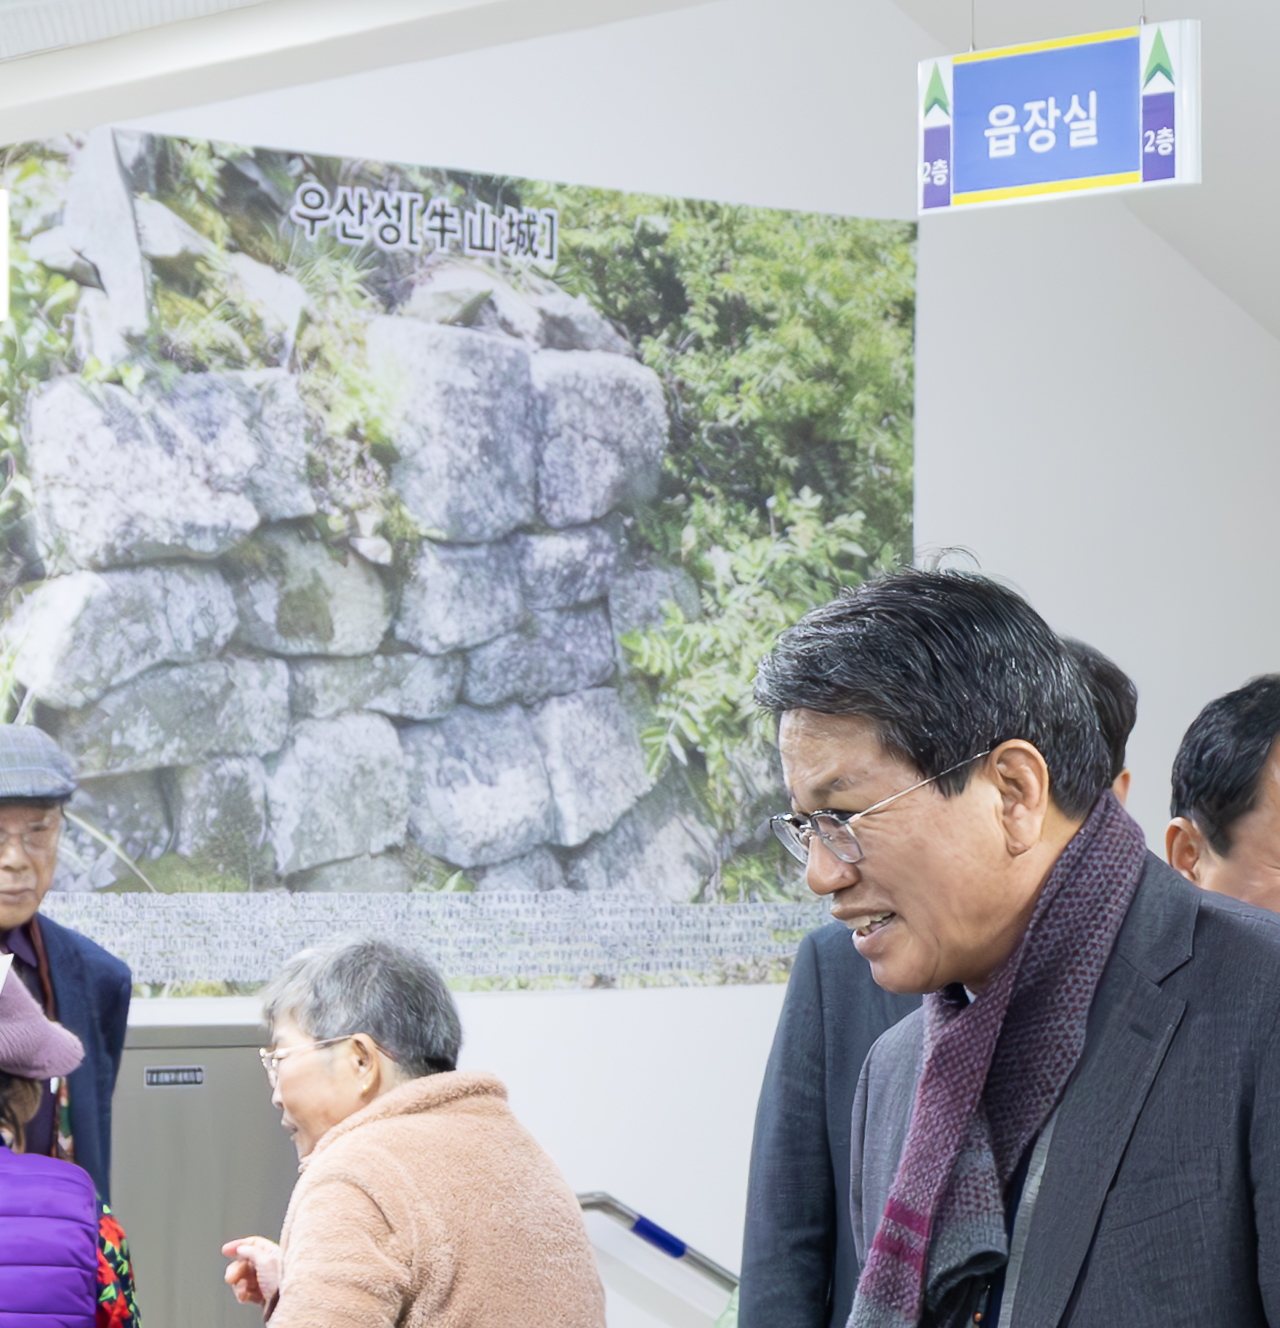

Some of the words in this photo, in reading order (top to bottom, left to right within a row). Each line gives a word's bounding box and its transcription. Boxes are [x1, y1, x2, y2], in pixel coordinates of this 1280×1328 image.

[983, 90, 1099, 159] 읍장실
[1143, 126, 1175, 156] 2층
[921, 158, 949, 185] 2층
